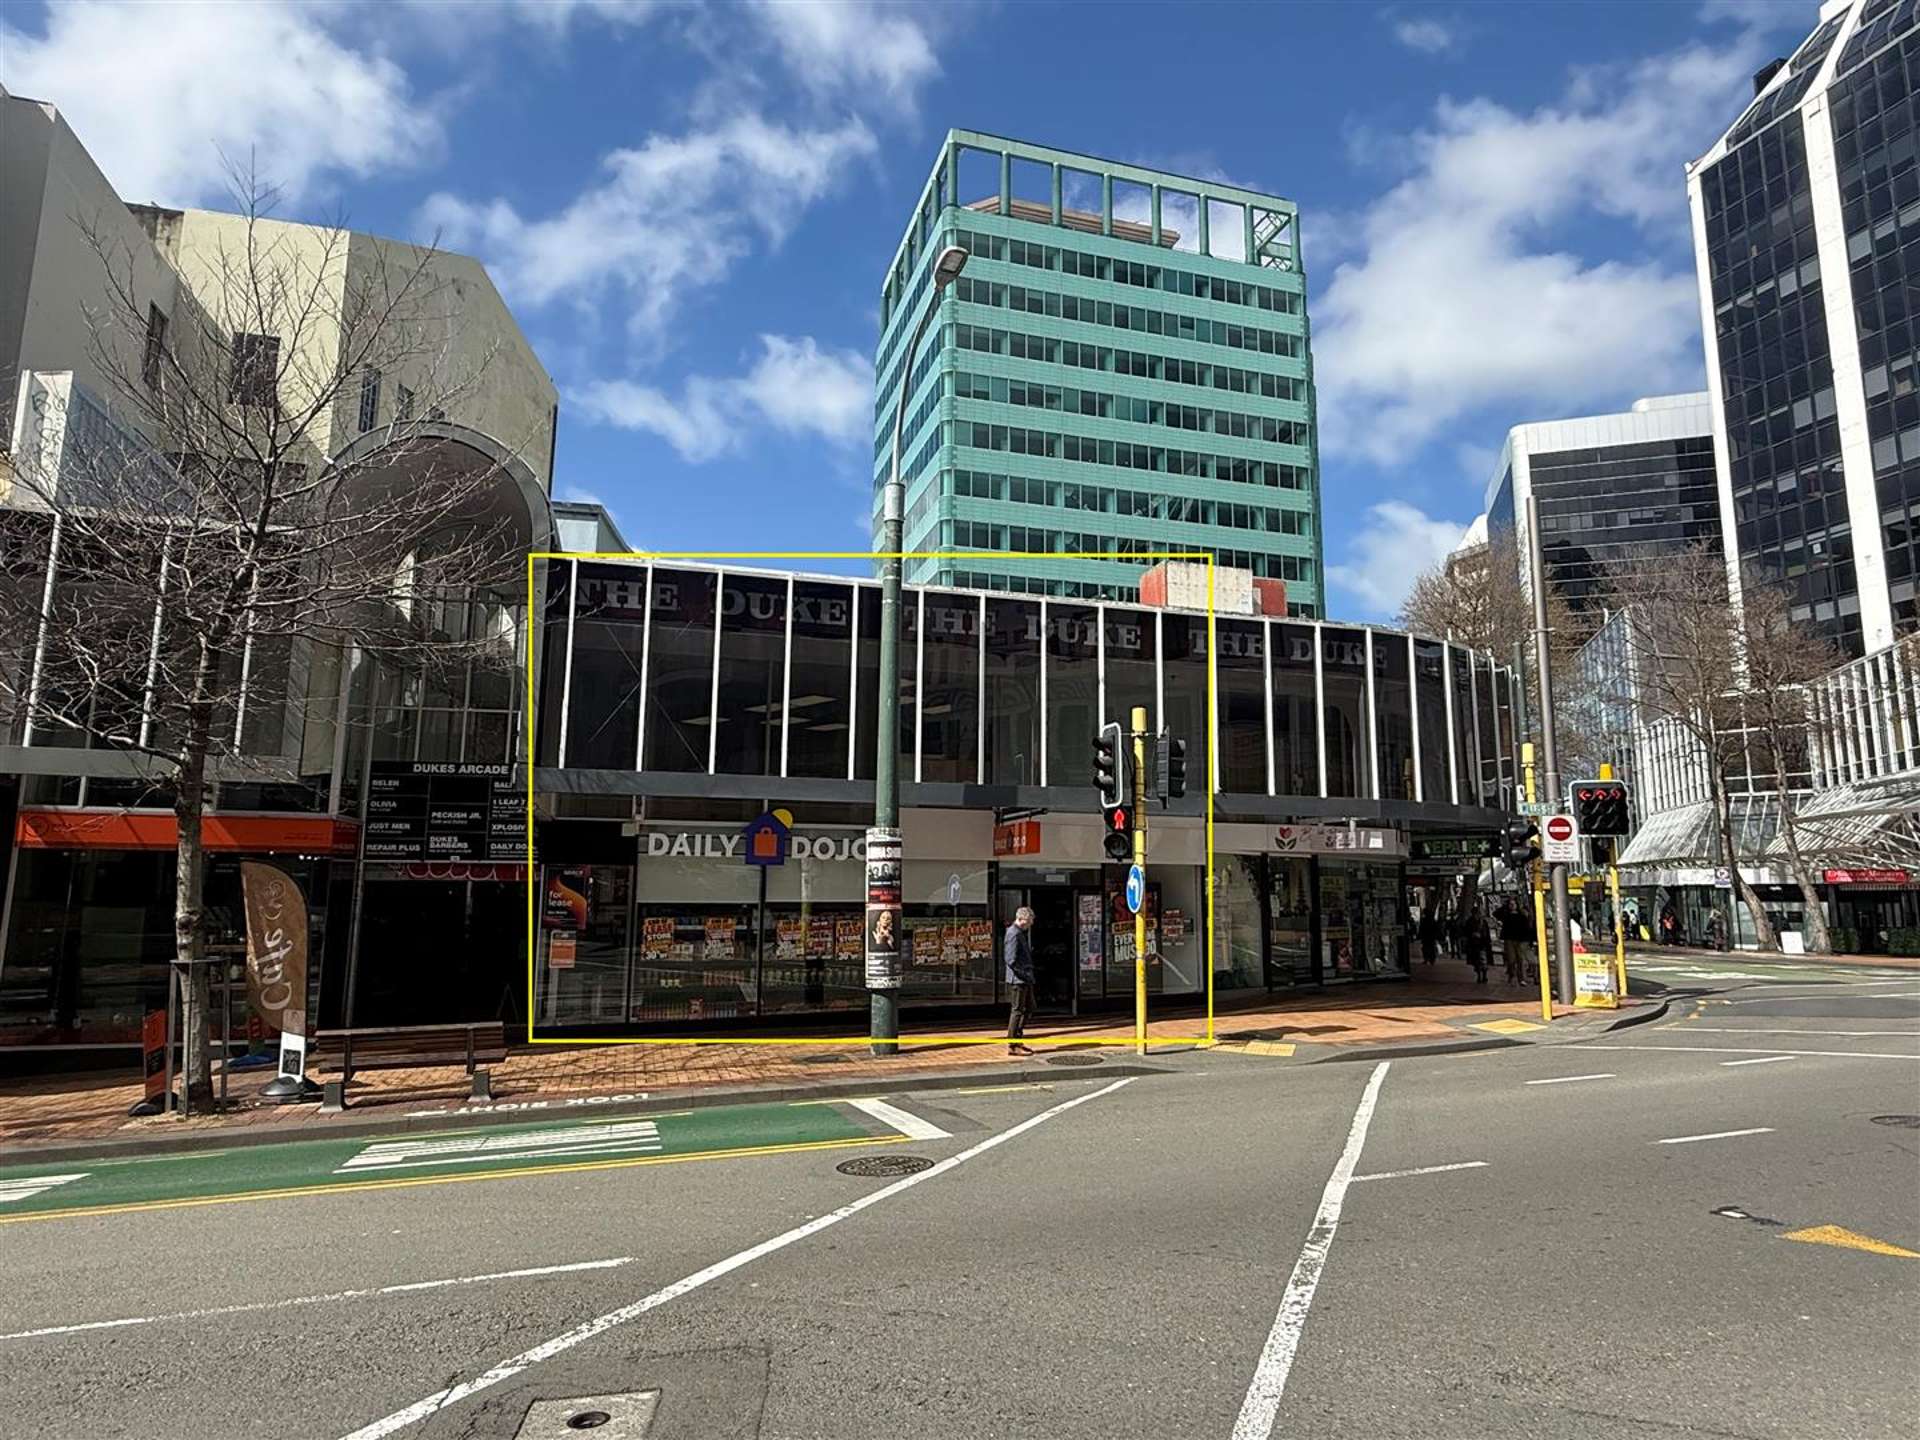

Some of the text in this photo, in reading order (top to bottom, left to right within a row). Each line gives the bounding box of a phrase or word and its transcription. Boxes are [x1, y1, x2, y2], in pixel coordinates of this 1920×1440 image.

[575, 577, 848, 626] THE DUKE
[903, 606, 1141, 649] THE DUKE
[1188, 627, 1388, 669] THE DUKE
[413, 763, 509, 775] DUKES ARCADE
[368, 822, 410, 830] JUST MEN
[398, 844, 421, 852] PLUS
[648, 832, 741, 858] DAILY
[791, 836, 866, 861] DOJO
[1114, 944, 1137, 963] MUS
[453, 1092, 650, 1115] LOOK RIGHT
